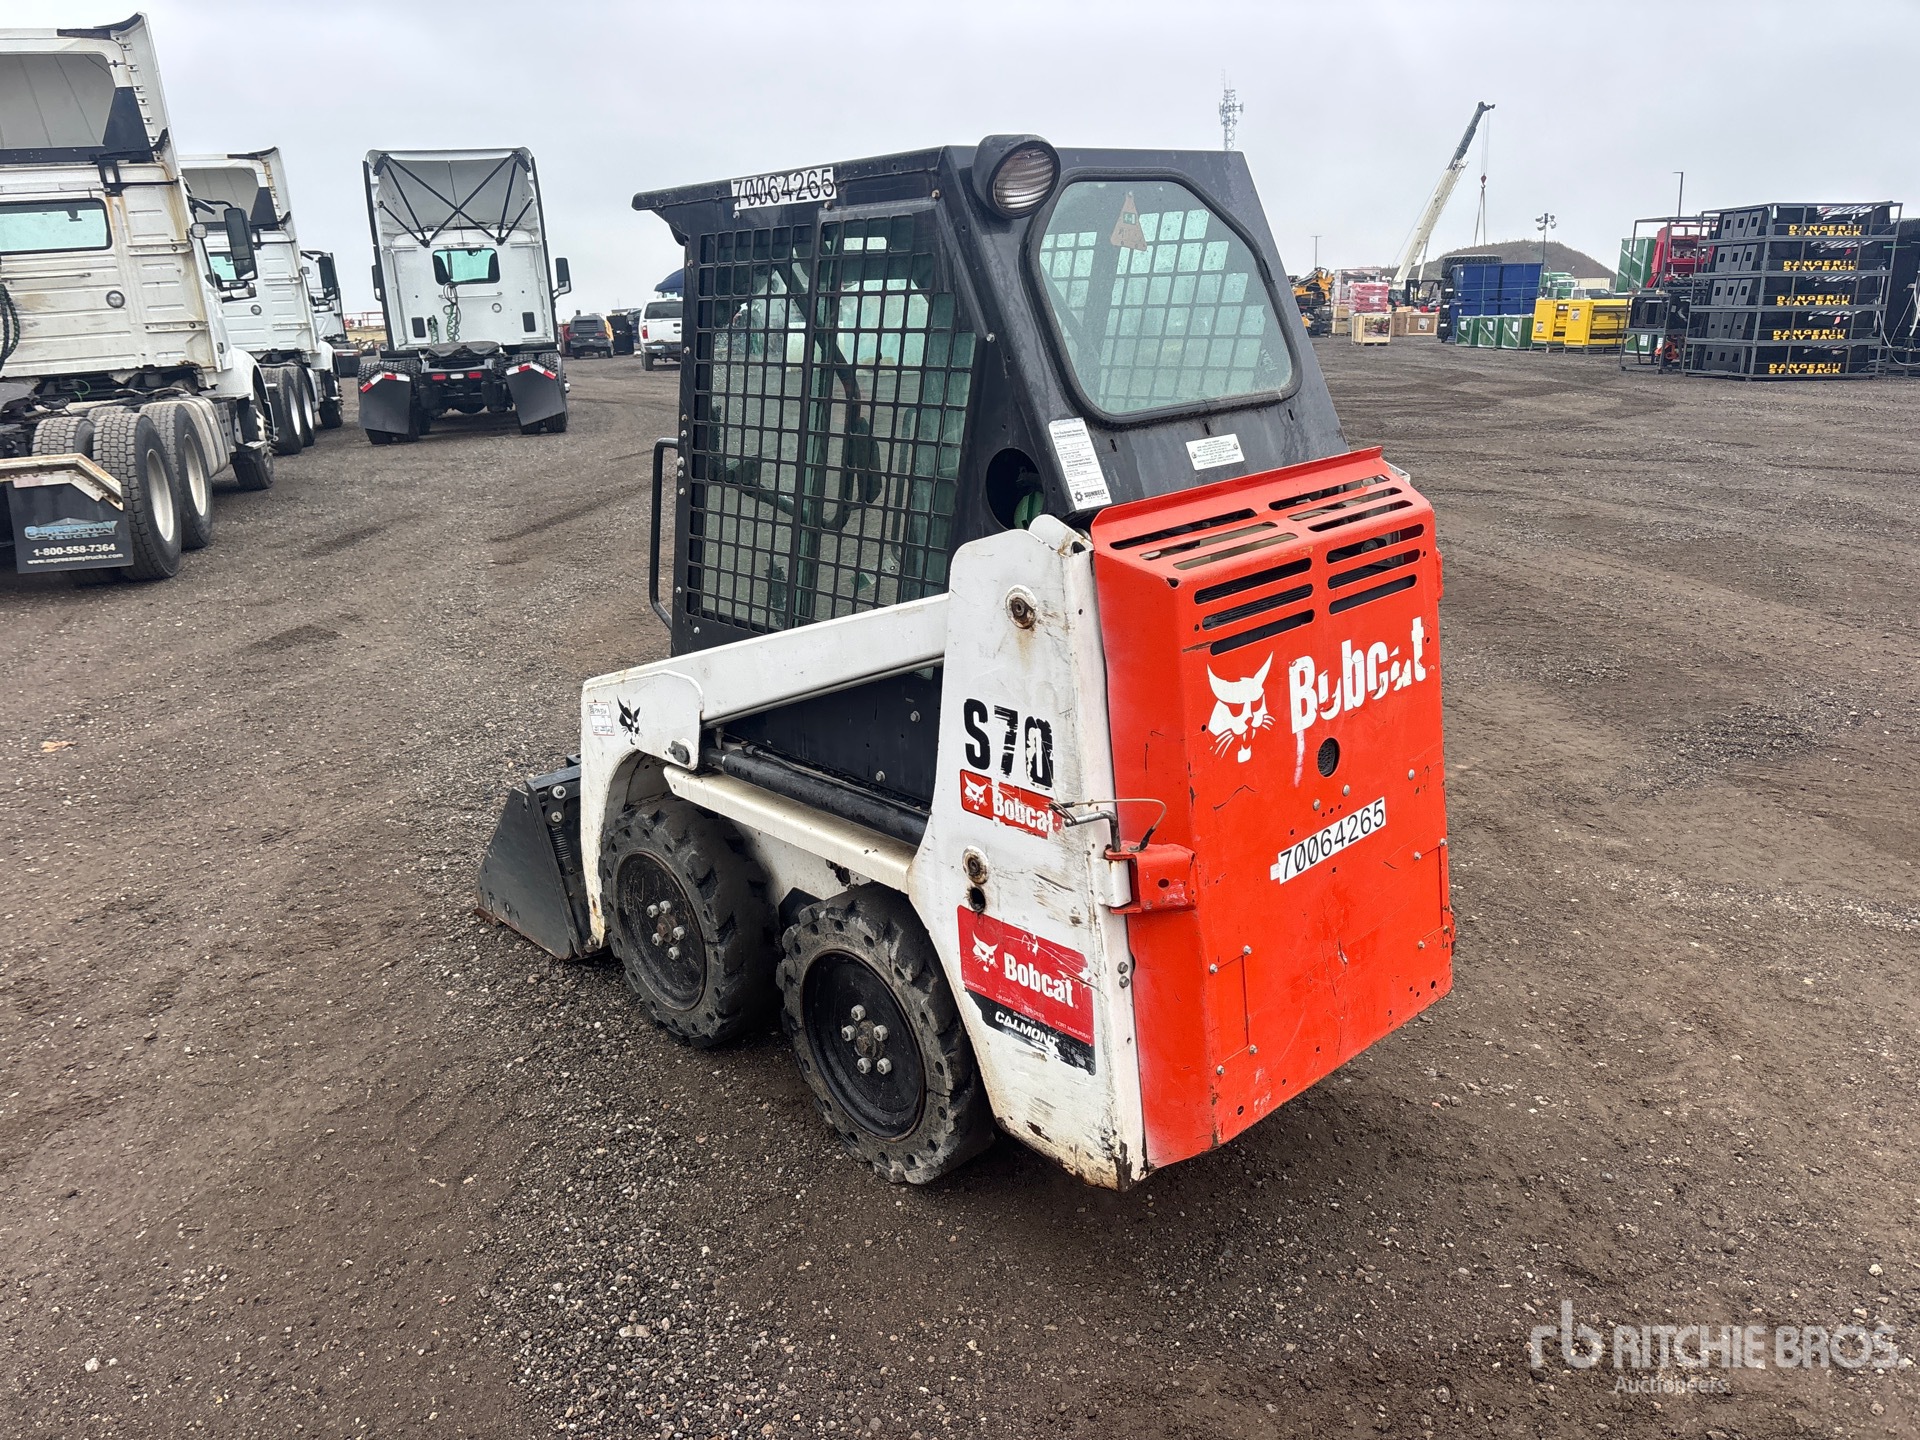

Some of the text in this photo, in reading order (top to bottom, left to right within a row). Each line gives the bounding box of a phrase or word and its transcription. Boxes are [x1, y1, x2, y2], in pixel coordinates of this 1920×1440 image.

[732, 168, 835, 208] 70064265
[33, 543, 117, 557] 1-800-558-7364
[48, 533, 99, 541] TRUCKS
[27, 552, 124, 565] www.expresswaytrucks.com
[963, 698, 1054, 790] S70
[992, 789, 1054, 833] Bobcat
[1280, 799, 1384, 880] 70064265
[1004, 951, 1074, 1008] Bobcat
[994, 1010, 1060, 1048] CALMONT
